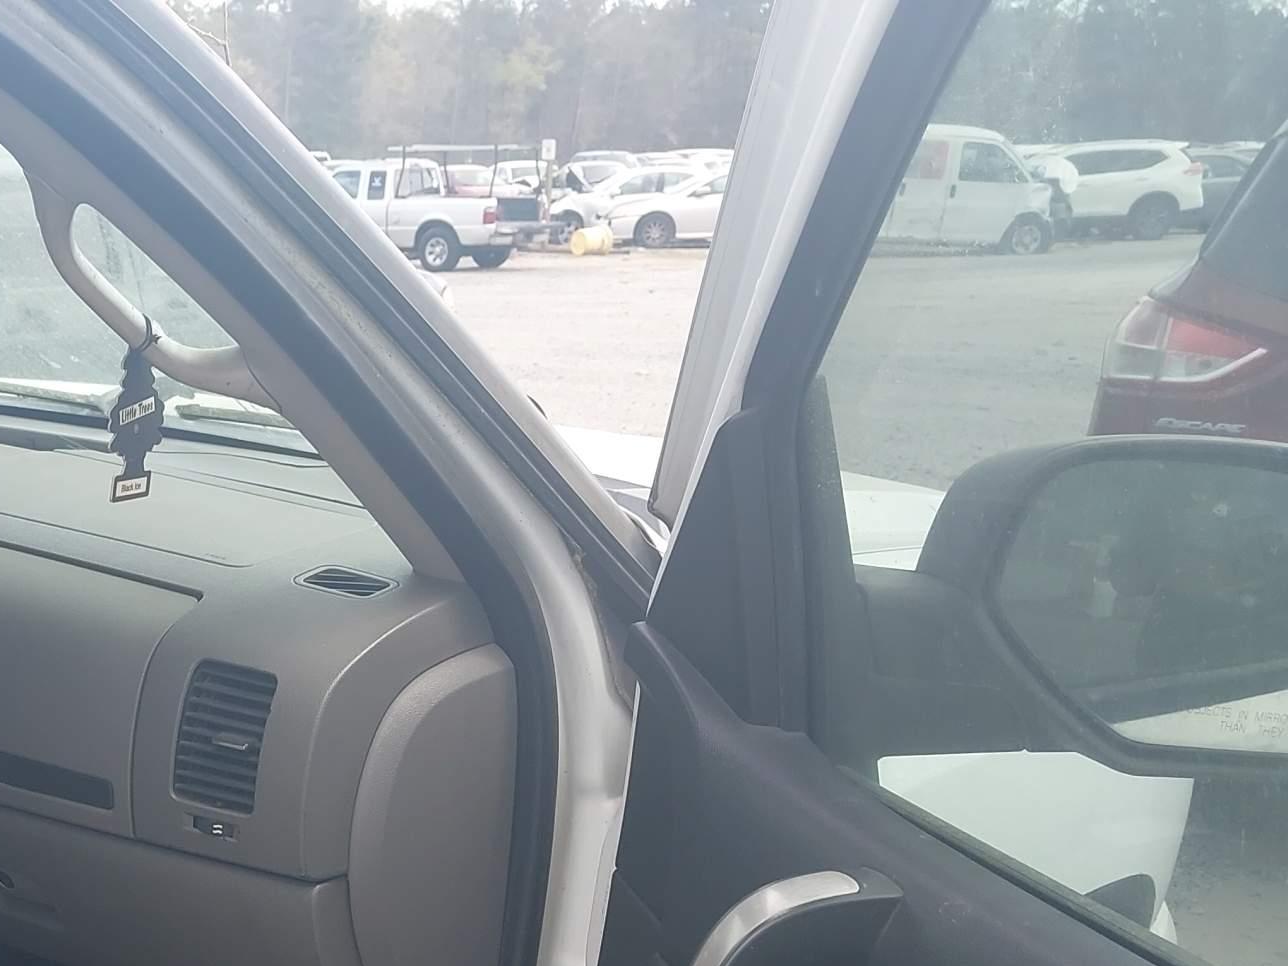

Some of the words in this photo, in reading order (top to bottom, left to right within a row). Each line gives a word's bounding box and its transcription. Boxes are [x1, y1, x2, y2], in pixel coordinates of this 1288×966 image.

[121, 406, 137, 424] Little
[137, 401, 153, 417] Trees
[1255, 711, 1288, 723] MIRRO
[1220, 720, 1246, 734] THAN
[1259, 724, 1285, 738] THEY
